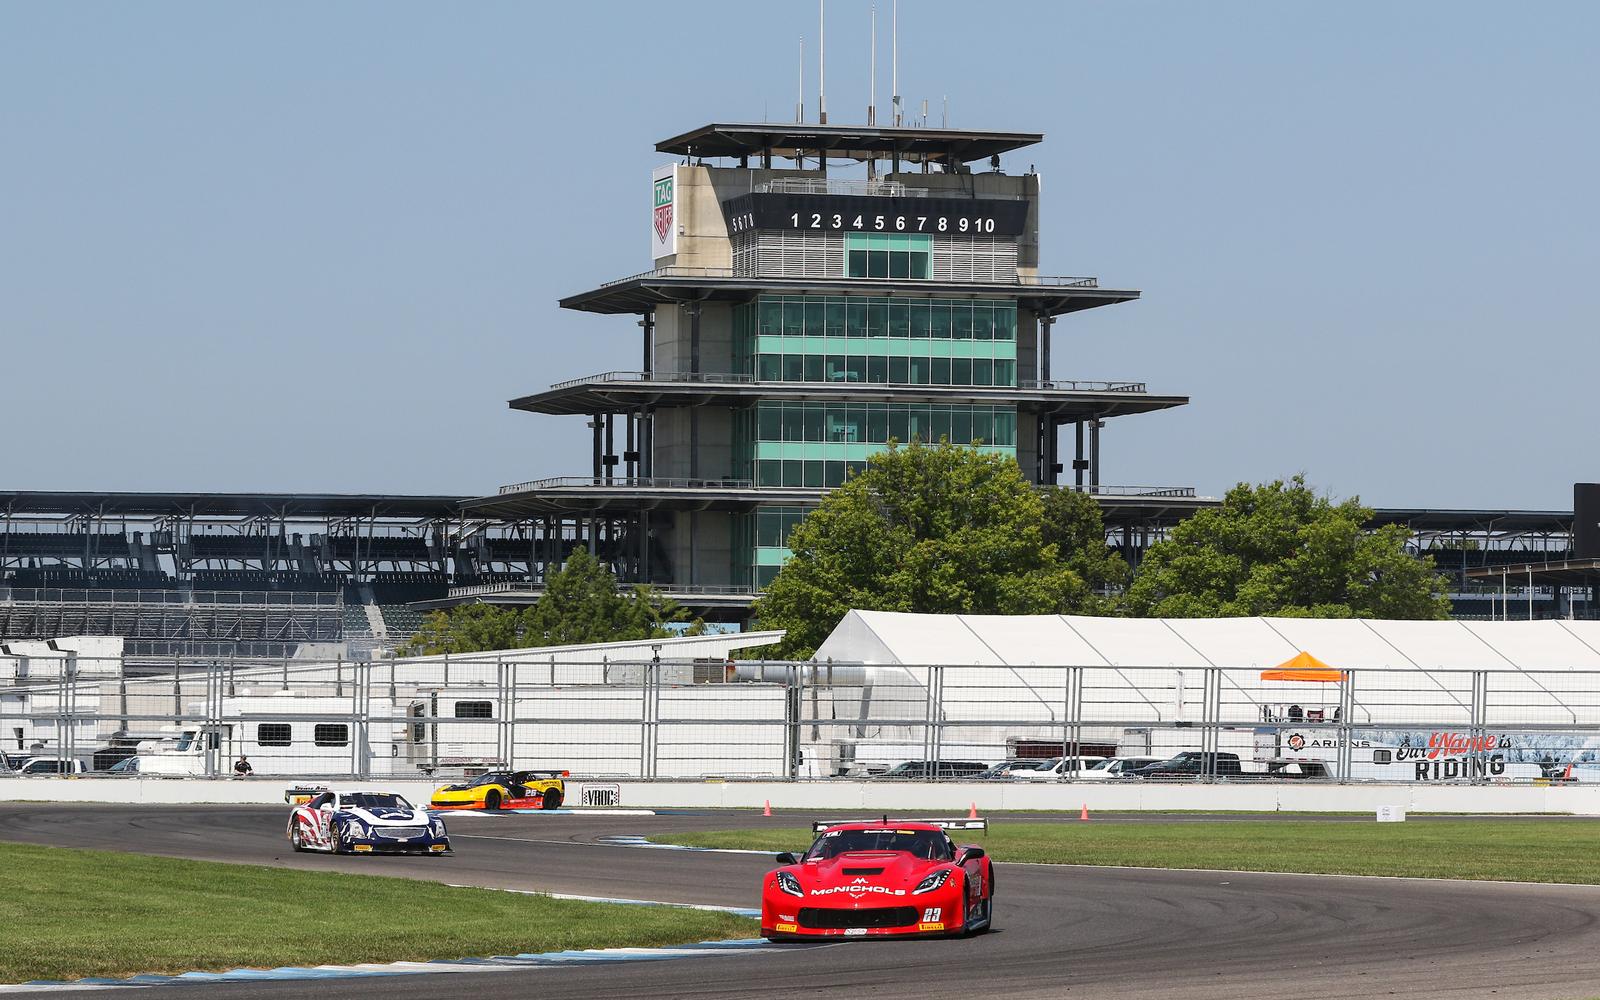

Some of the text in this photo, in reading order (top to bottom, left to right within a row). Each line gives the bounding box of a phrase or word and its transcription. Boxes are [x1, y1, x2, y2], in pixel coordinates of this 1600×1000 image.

[655, 182, 672, 204] TAG
[655, 206, 673, 236] HEUER
[732, 217, 738, 233] 5
[737, 216, 743, 231] 6
[748, 212, 754, 227] 8
[791, 212, 995, 233] 1 2 3 4 5 6 7 8 9 10
[1427, 732, 1497, 760] Name
[1499, 734, 1511, 748] is
[1415, 754, 1505, 781] RIDING
[524, 789, 542, 797] 26
[587, 789, 614, 806] VROC
[922, 907, 942, 922] 23
